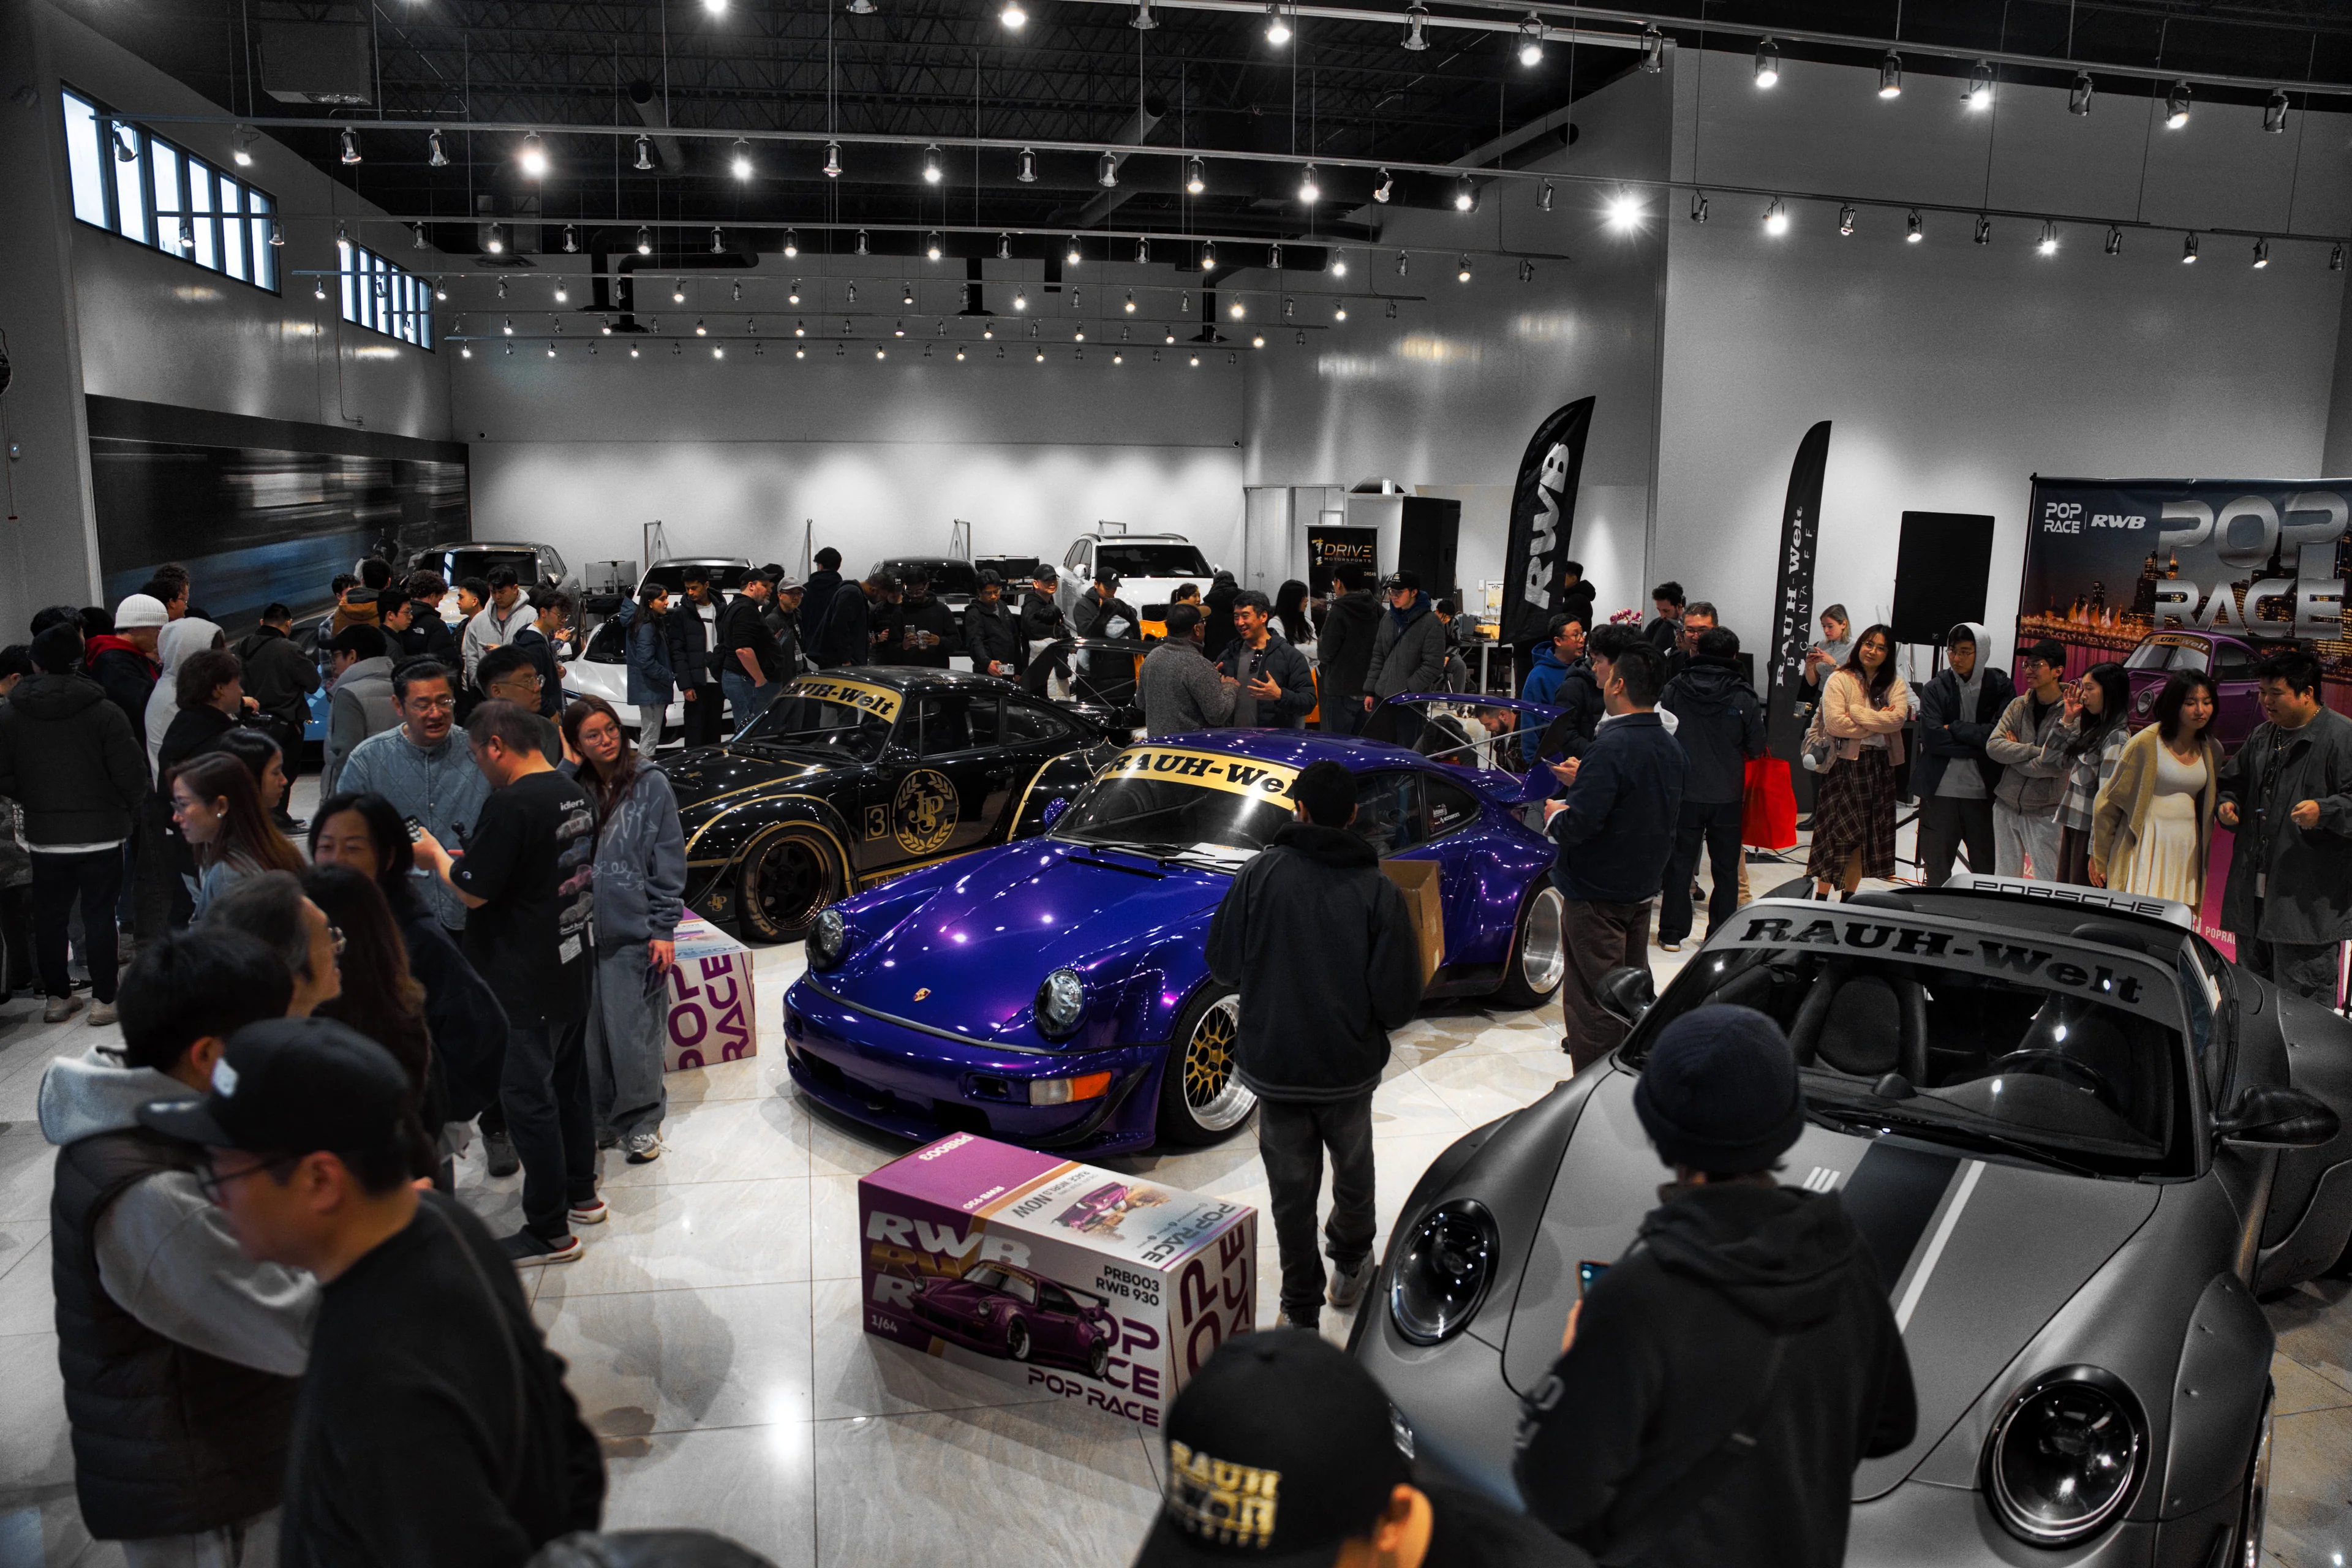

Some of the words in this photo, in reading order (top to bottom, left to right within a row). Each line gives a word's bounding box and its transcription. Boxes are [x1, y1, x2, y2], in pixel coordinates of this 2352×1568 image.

[2046, 502, 2081, 518] POP
[2091, 514, 2146, 529] RWB
[1524, 442, 1569, 609] RWB
[2044, 519, 2080, 533] RACE
[2157, 491, 2349, 569] POP
[1324, 543, 1373, 557] DRIVE
[2154, 578, 2345, 640] RACE
[560, 799, 585, 811] idlers
[869, 808, 886, 837] 3
[1973, 881, 2166, 916] PORSCHE
[1739, 918, 2143, 1005] RAUH-Welt
[918, 1134, 974, 1161] PRB003
[1012, 1194, 1053, 1219] NOW
[1195, 1202, 1237, 1230] POP
[866, 1210, 1031, 1268] RWB
[1140, 1227, 1200, 1263] RACE
[1096, 1276, 1129, 1297] RWB
[1133, 1288, 1159, 1306] 930
[1104, 1265, 1159, 1292] PRB003
[871, 1314, 898, 1333] 1/64
[1028, 1366, 1084, 1398] POP
[1087, 1387, 1159, 1428] RACE
